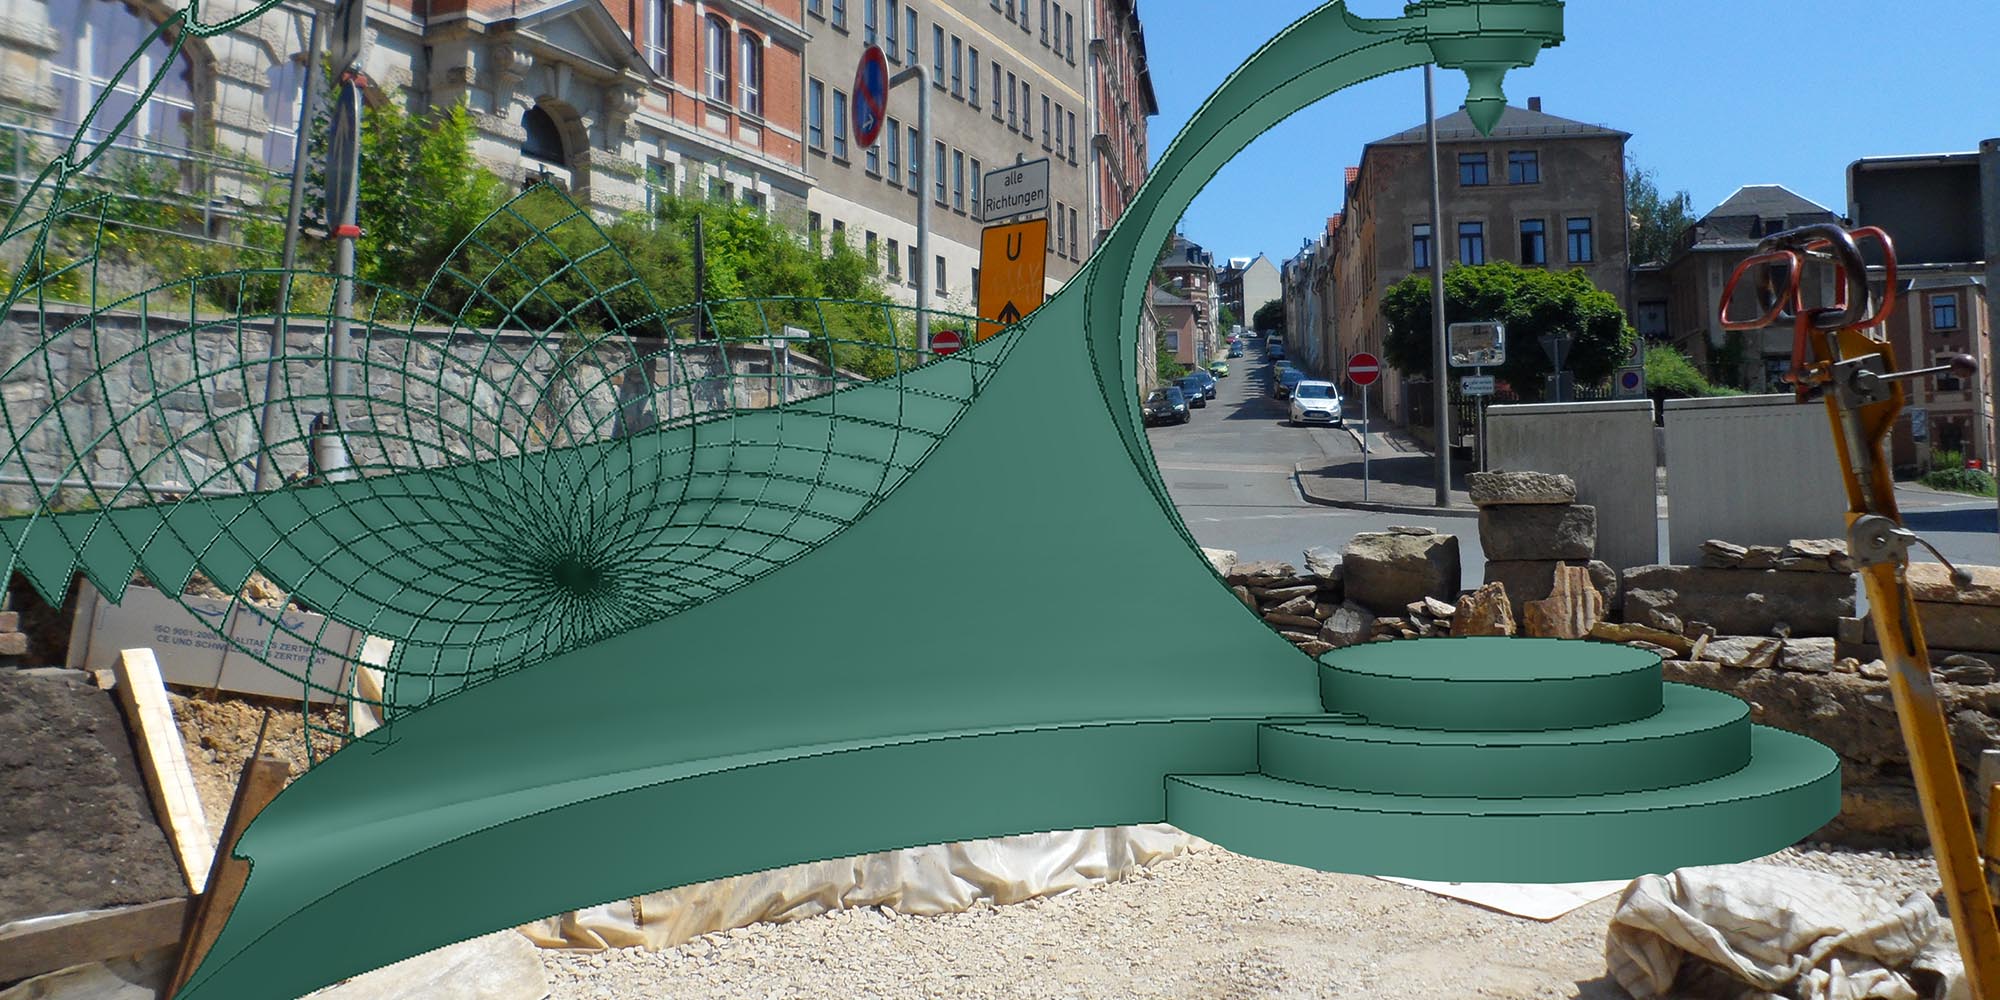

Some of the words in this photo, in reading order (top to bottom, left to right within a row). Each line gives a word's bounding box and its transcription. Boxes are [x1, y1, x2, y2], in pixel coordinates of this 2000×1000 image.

[1004, 172, 1023, 187] alle
[985, 188, 1044, 213] Richtungen
[1007, 232, 1022, 261] U
[156, 634, 169, 643] CE
[172, 637, 193, 646] UND
[274, 651, 327, 664] ZERTIFIAT
